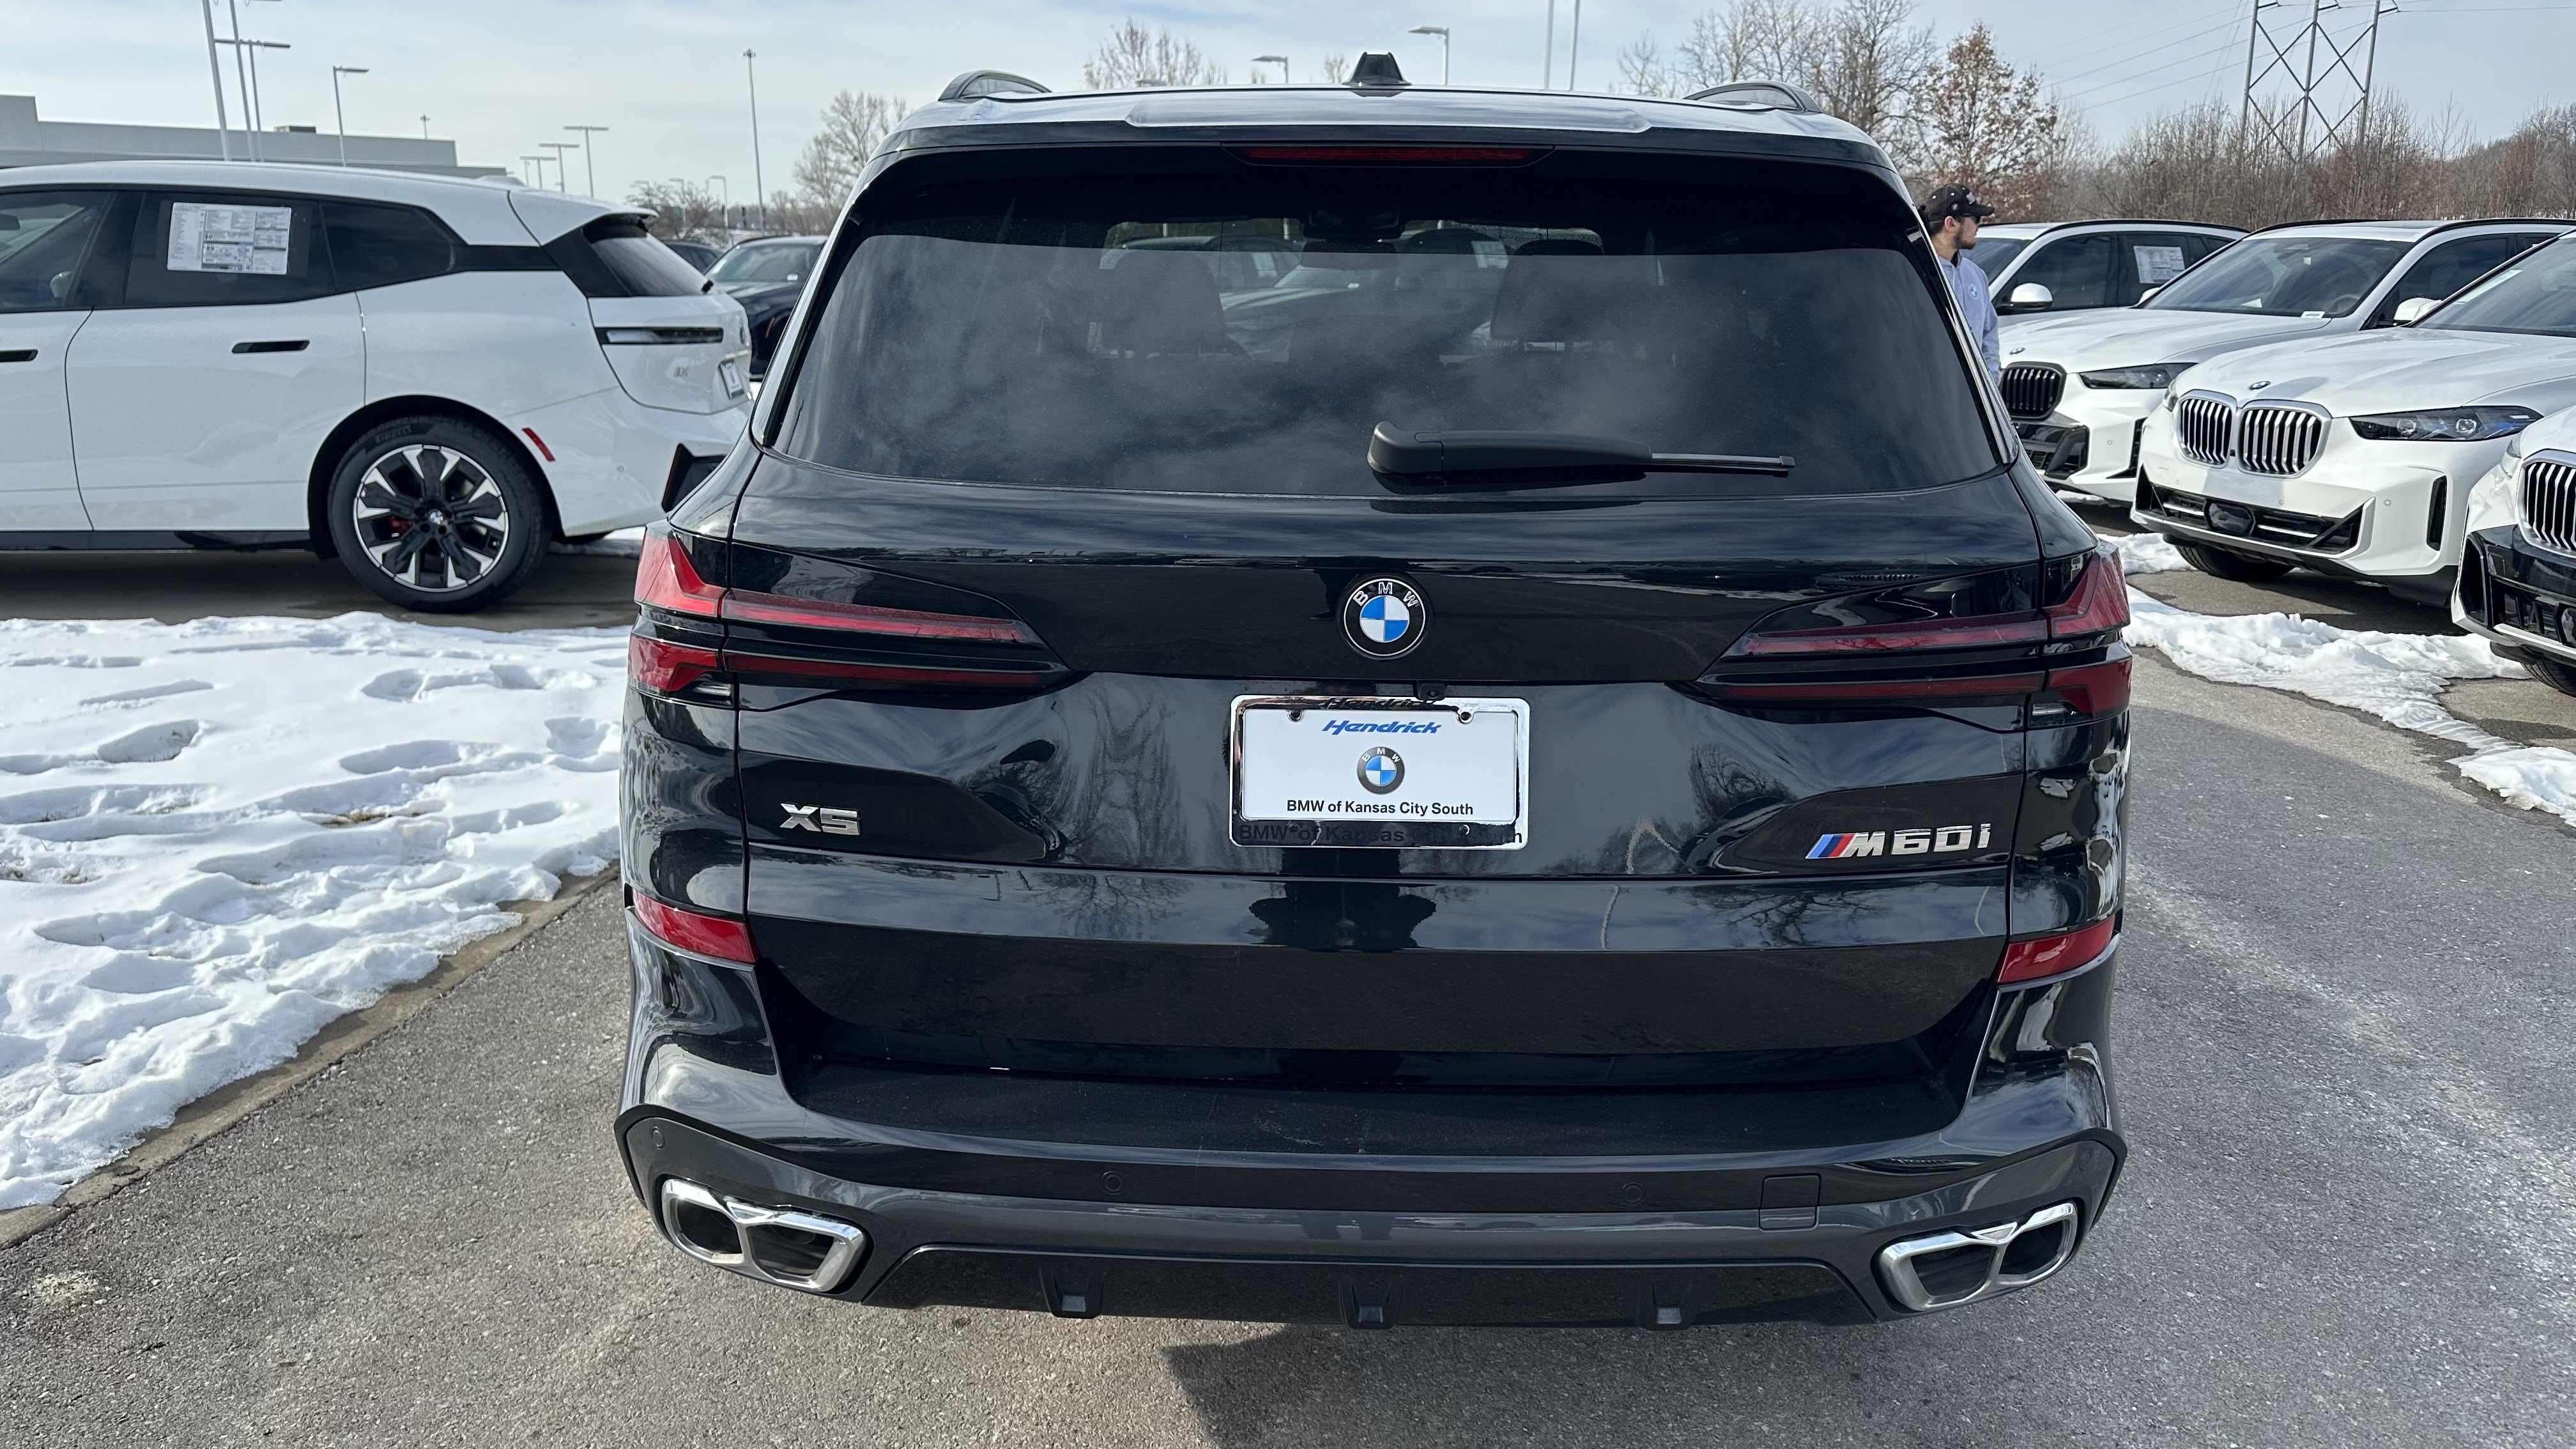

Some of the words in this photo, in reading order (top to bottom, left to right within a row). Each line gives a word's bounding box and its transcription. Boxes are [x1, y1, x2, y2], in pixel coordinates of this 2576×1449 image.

[1353, 581, 1420, 608] BMW
[1322, 719, 1442, 735] Hendrick
[1361, 747, 1401, 763] BMW
[1287, 799, 1324, 812] BMW
[1328, 801, 1342, 813] of
[1345, 801, 1396, 814] Kansas
[1399, 801, 1429, 817] City
[1431, 802, 1474, 815] South
[779, 802, 861, 836] X5
[1239, 825, 1287, 840] BMW
